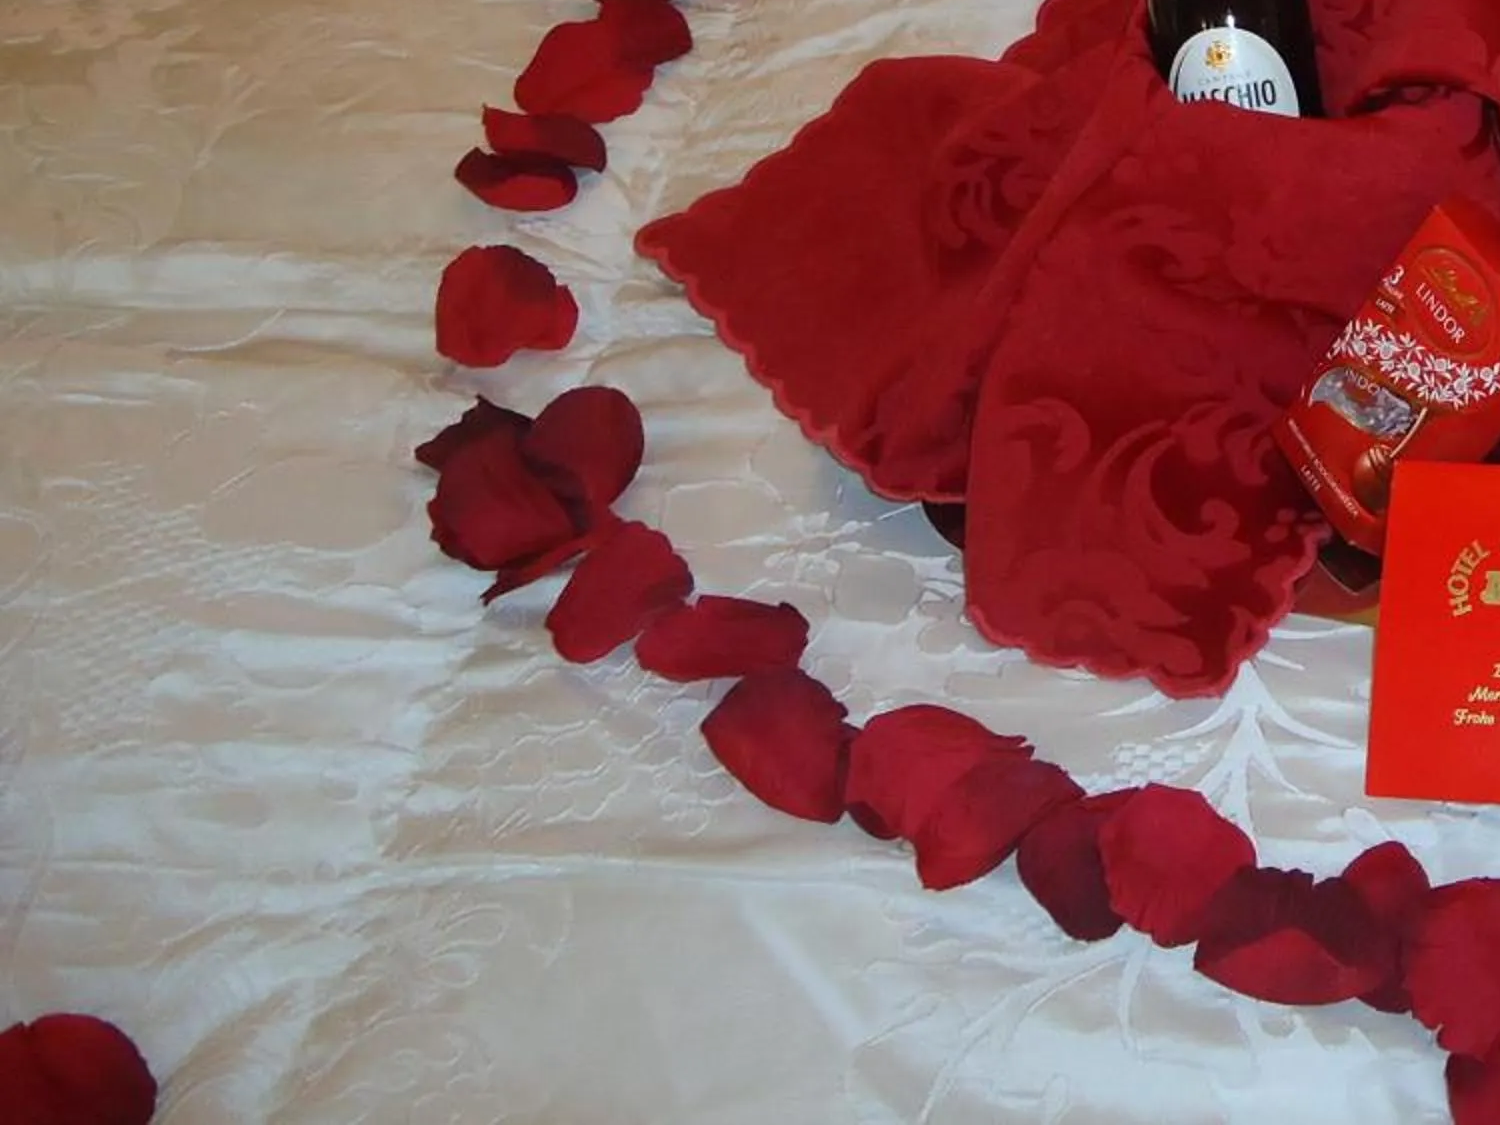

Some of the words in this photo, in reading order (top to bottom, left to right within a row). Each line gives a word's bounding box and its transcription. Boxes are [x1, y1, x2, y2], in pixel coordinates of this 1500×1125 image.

[1415, 282, 1466, 344] LINDOR
[1447, 538, 1491, 617] HOTEL
[1454, 708, 1495, 726] Frohe
